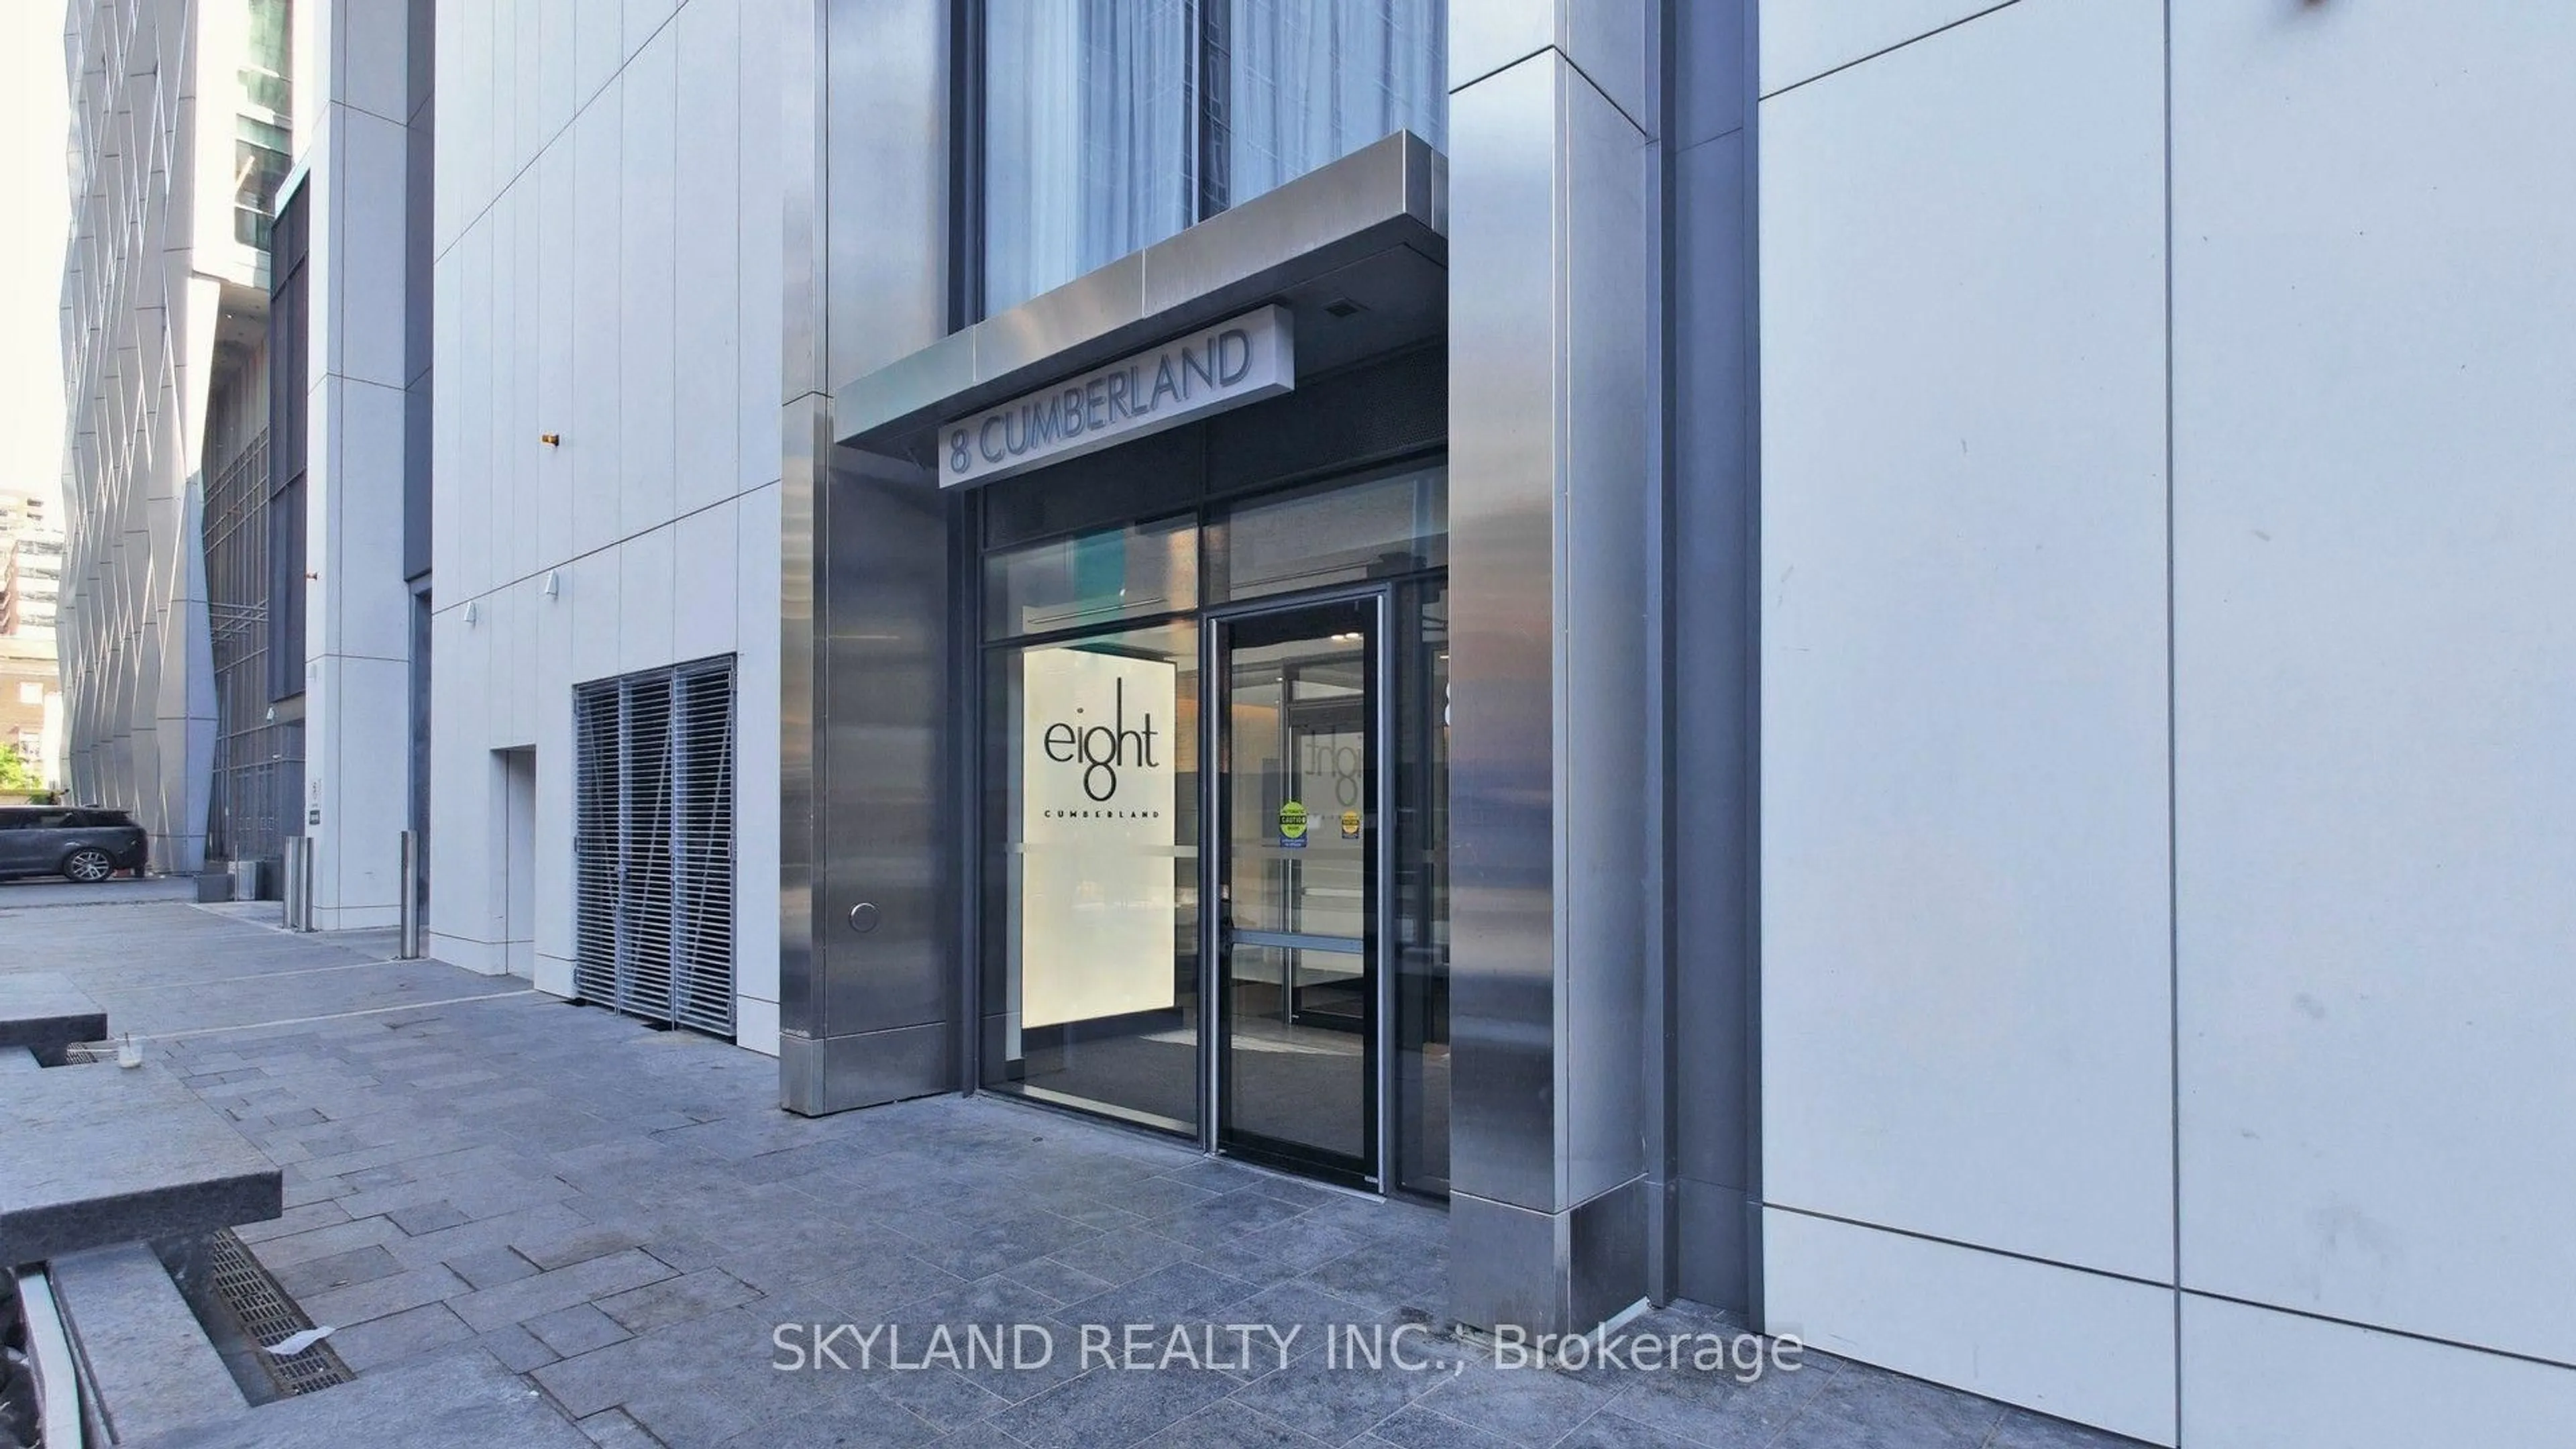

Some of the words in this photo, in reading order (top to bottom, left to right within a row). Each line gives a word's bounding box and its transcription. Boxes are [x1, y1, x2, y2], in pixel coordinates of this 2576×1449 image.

[950, 428, 971, 474] 8
[979, 327, 1253, 464] CUMBERLAND
[1044, 677, 1160, 802] eight
[1044, 810, 1159, 818] CUMBERLAND
